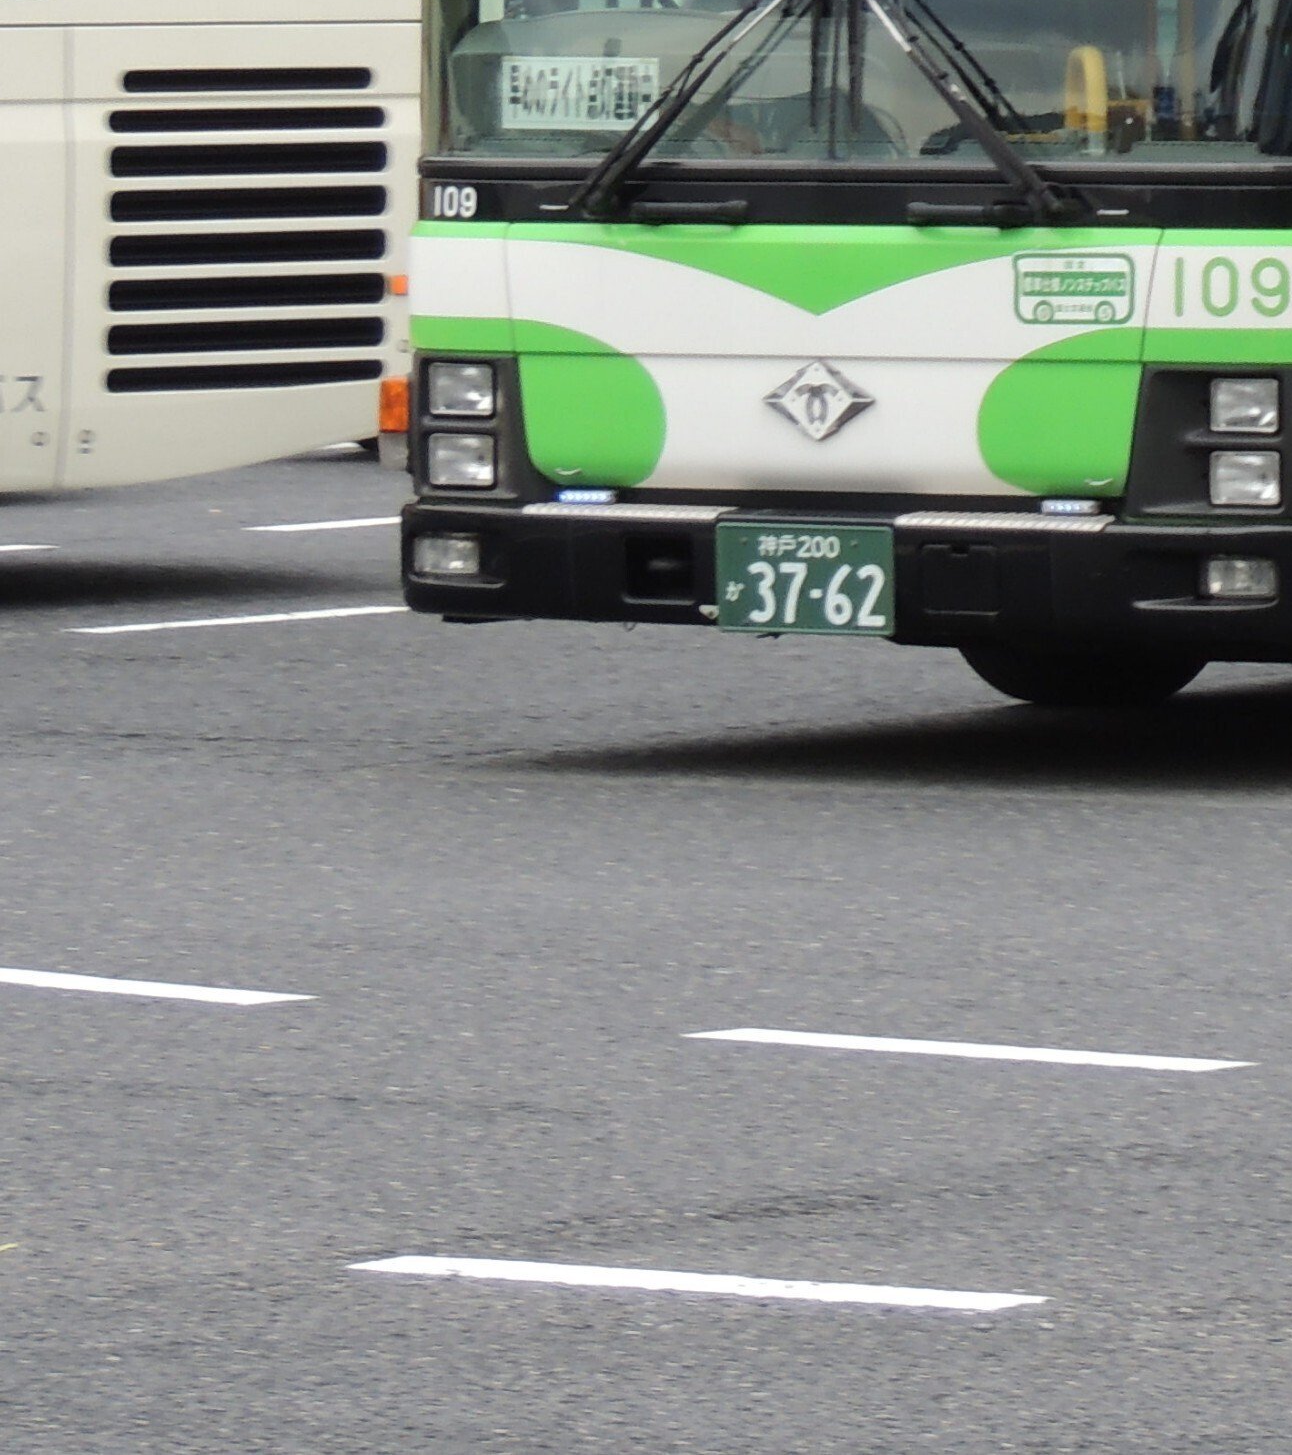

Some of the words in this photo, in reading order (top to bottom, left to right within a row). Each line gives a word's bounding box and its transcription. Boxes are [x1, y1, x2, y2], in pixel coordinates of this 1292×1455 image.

[433, 185, 478, 218] 109
[1173, 255, 1291, 318] 109
[0, 375, 45, 414] ス
[747, 560, 887, 628] 37-62
